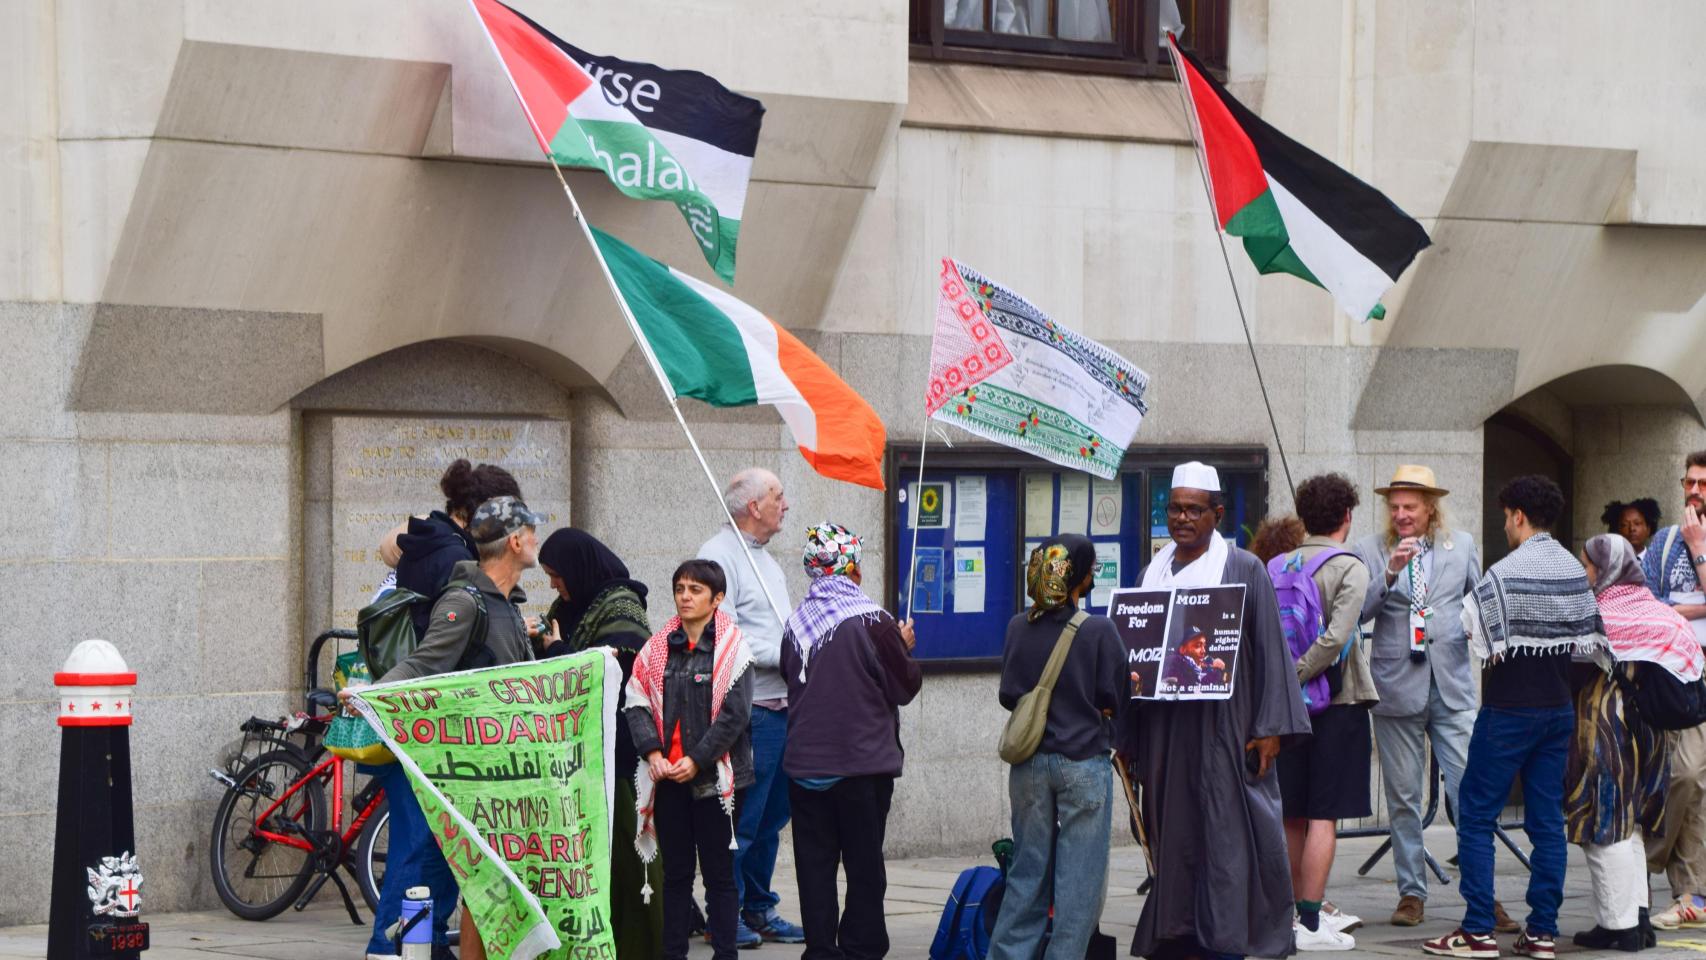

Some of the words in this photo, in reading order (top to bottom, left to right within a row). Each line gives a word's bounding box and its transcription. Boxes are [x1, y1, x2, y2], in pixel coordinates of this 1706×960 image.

[1176, 594, 1210, 605] MOIZ
[1116, 602, 1164, 615] Freedom
[1128, 617, 1148, 628] For
[1214, 628, 1240, 636] human
[1209, 644, 1238, 652] defende
[1129, 647, 1163, 663] MOIZ
[376, 687, 443, 714] STOP
[451, 687, 481, 700] THE
[488, 661, 594, 705] GENOCIDE
[1188, 683, 1228, 692] criminal
[391, 702, 588, 746] SOLIDARITY
[424, 750, 541, 788] لفلسطي
